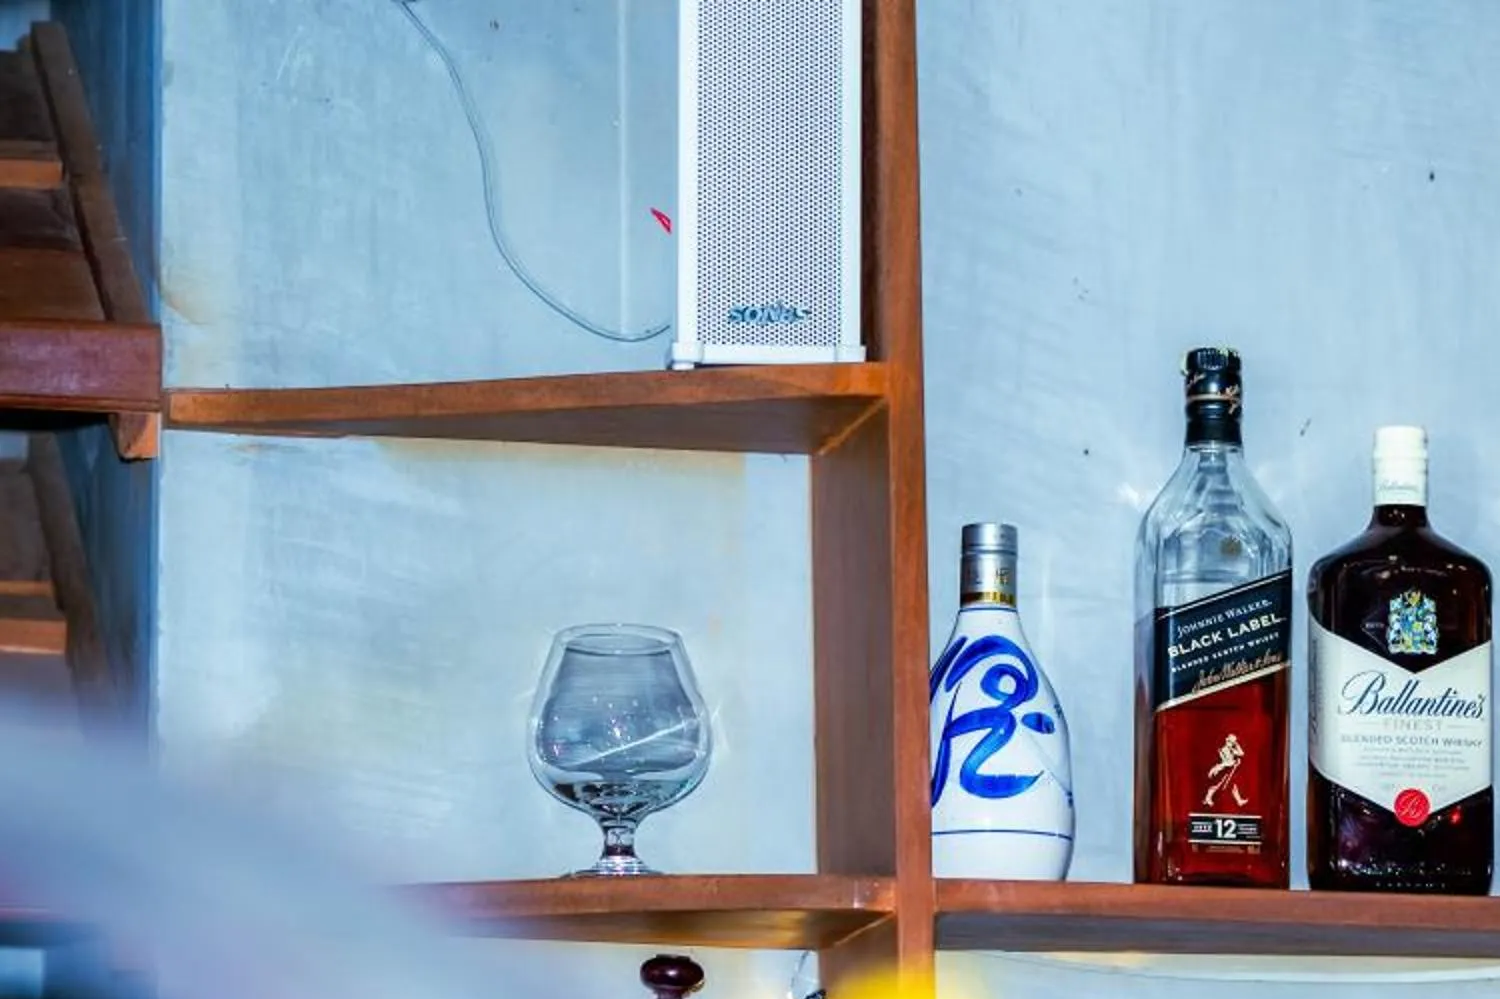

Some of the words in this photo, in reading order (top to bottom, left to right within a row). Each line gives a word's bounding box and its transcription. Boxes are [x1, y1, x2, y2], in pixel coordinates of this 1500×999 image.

[1167, 630, 1223, 657] BLACK
[1227, 613, 1281, 638] LABEL
[1338, 670, 1486, 720] Ballantine's
[1383, 720, 1443, 731] FINEST
[1395, 735, 1439, 746] SCOTCH
[1215, 819, 1237, 838] 12
